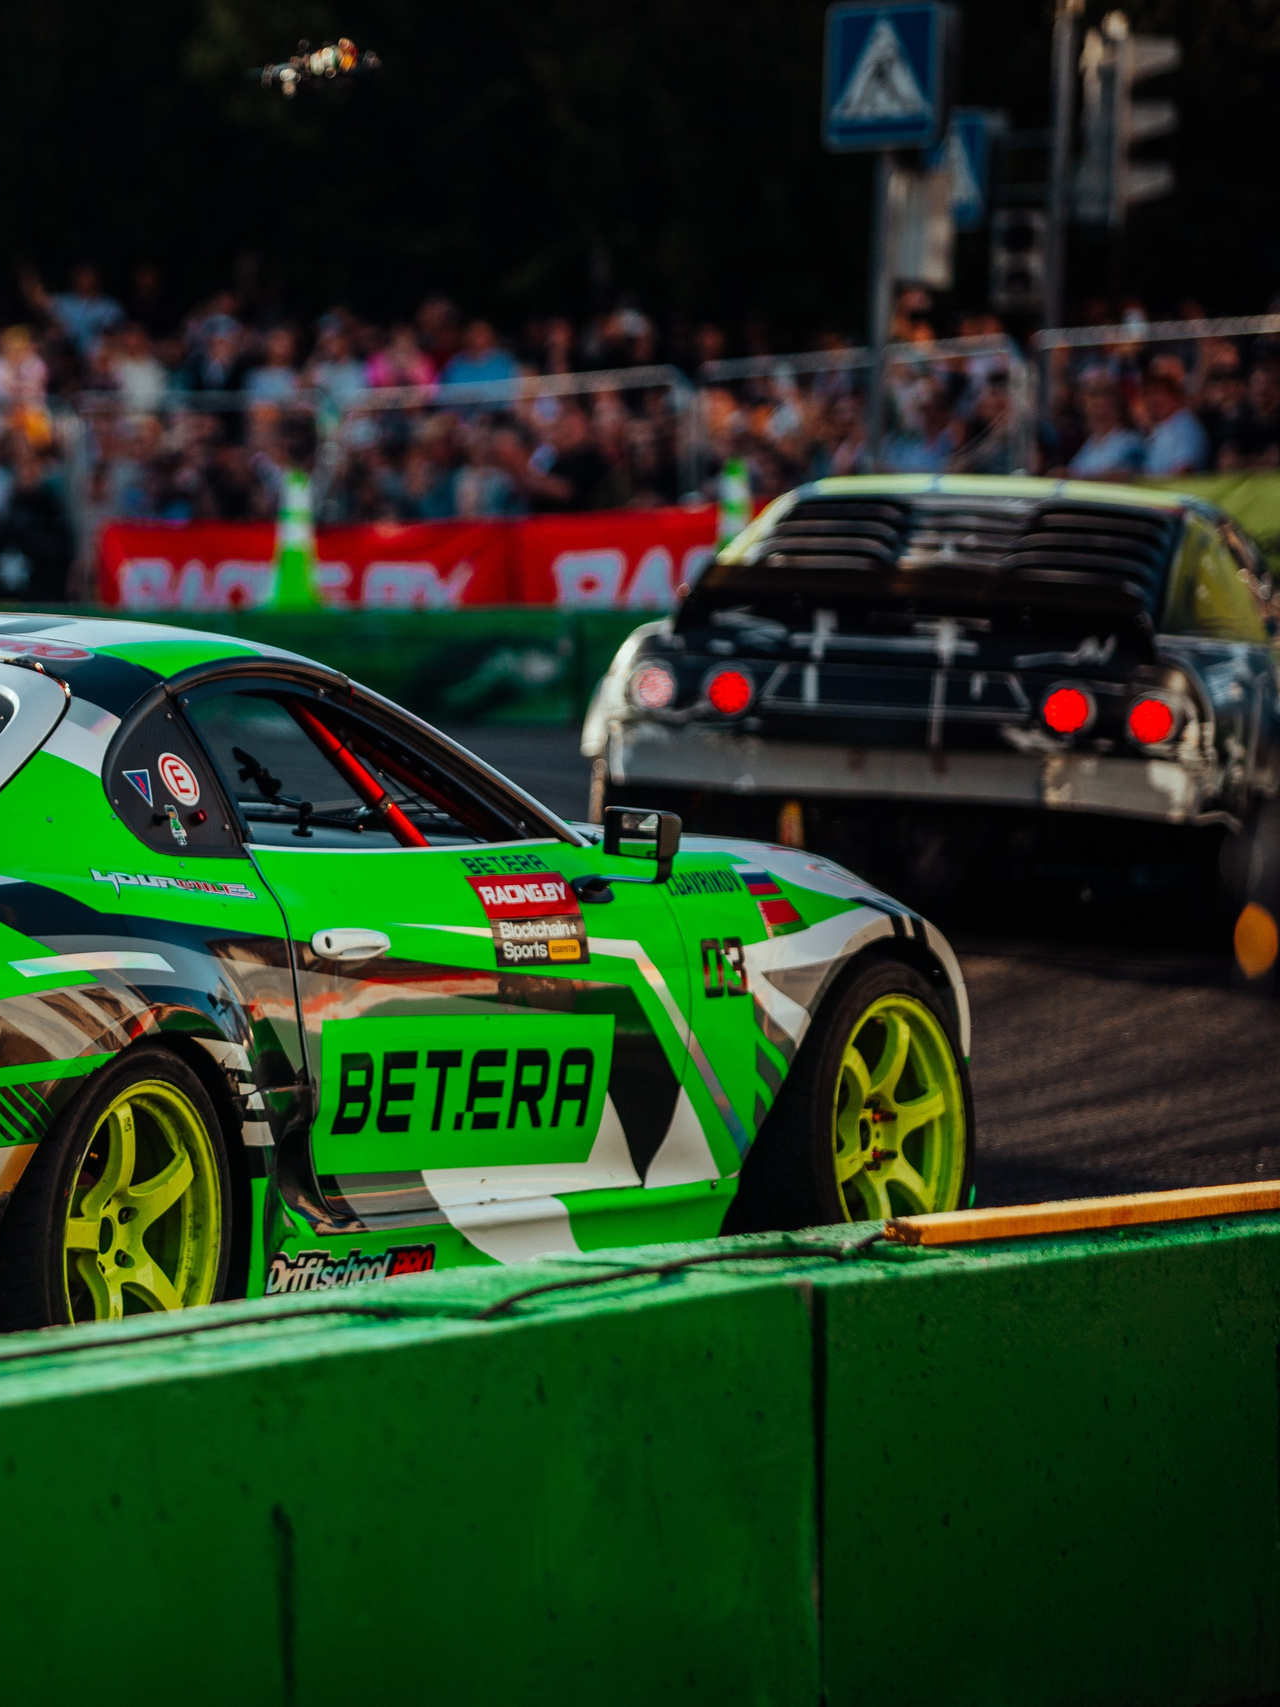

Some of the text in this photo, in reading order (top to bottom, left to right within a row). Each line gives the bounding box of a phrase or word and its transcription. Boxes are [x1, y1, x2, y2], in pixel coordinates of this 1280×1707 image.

[498, 920, 570, 939] Blockchain
[502, 941, 548, 962] Sports
[701, 936, 748, 998] 03
